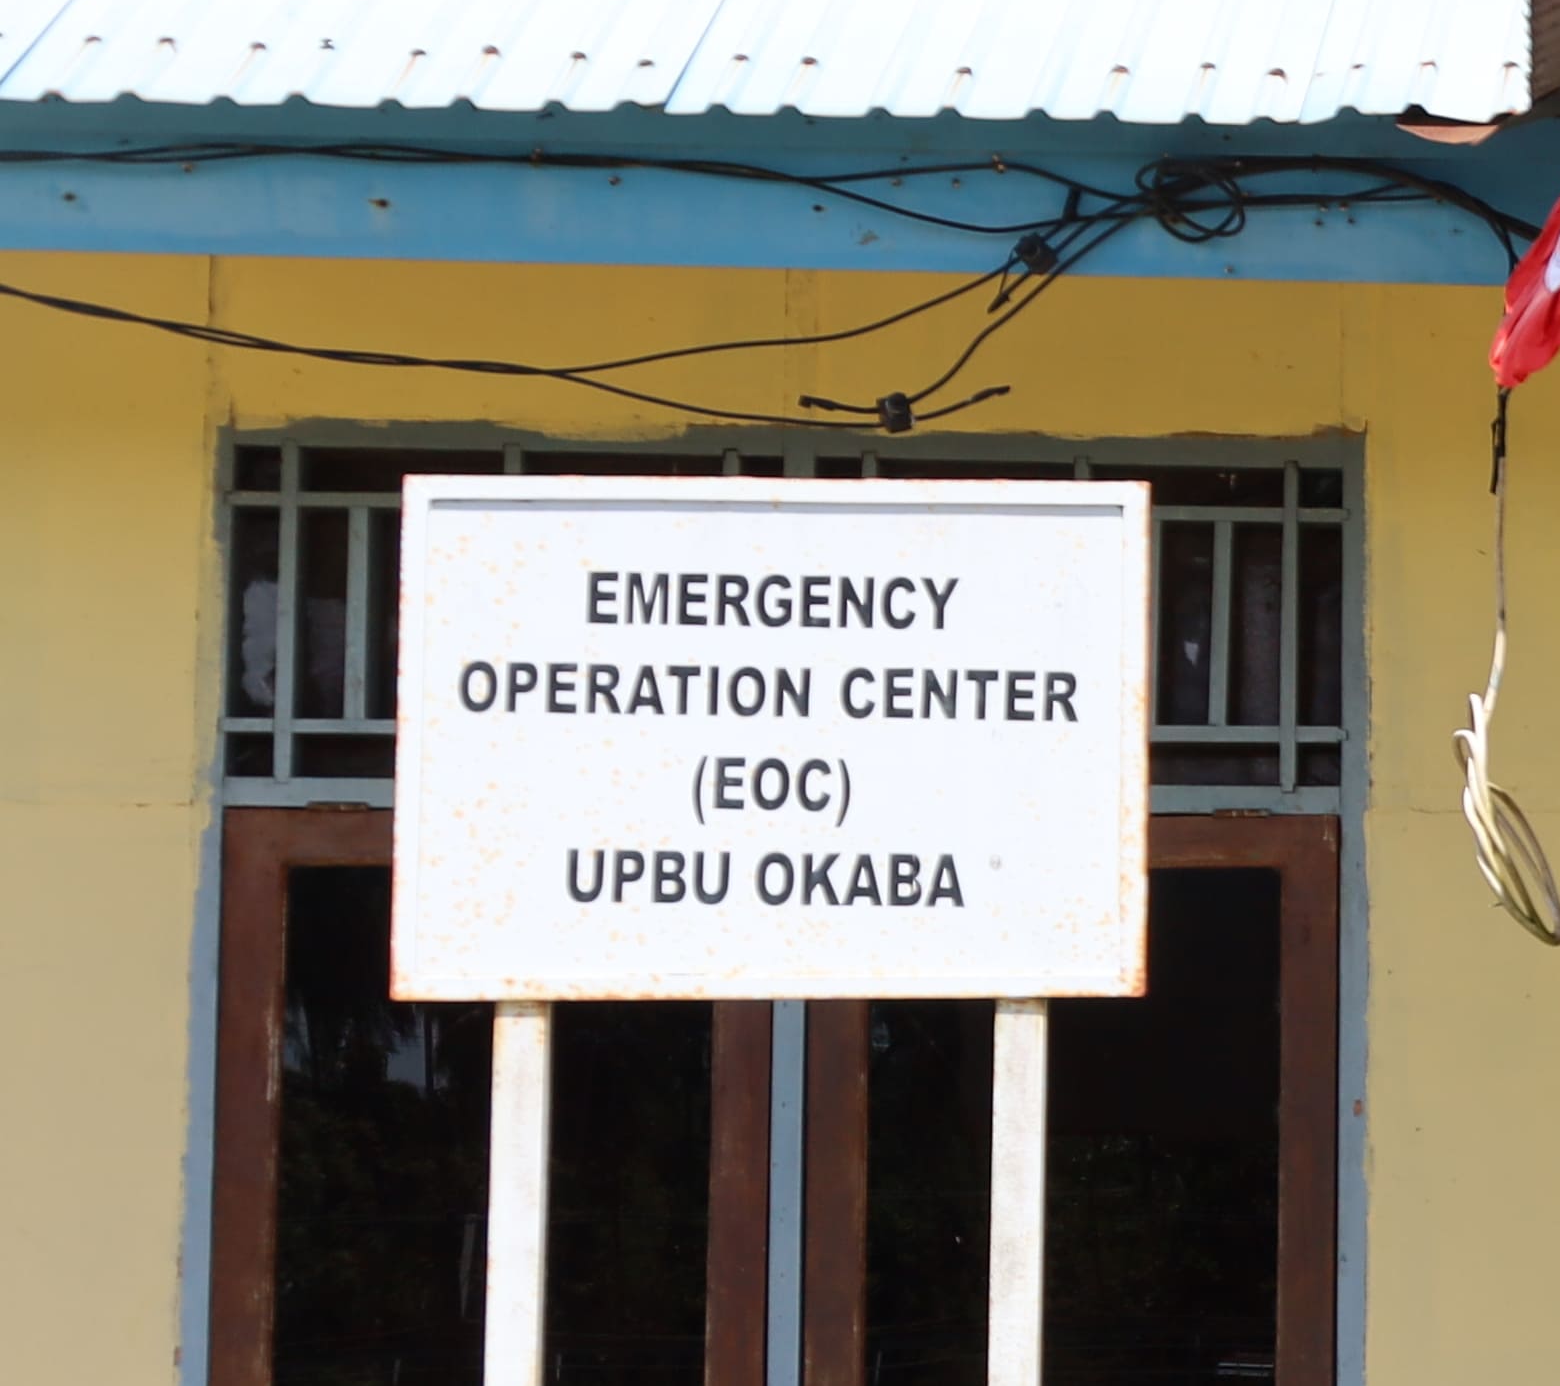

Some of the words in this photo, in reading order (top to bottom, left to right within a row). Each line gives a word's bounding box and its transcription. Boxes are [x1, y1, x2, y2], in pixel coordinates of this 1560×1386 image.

[586, 570, 959, 630] EMERGENCY
[459, 660, 812, 718] OPERATION
[840, 667, 1079, 723] CENTER
[692, 755, 852, 827] (EOC)
[567, 849, 731, 905] UPBU
[755, 852, 966, 909] OKABA
